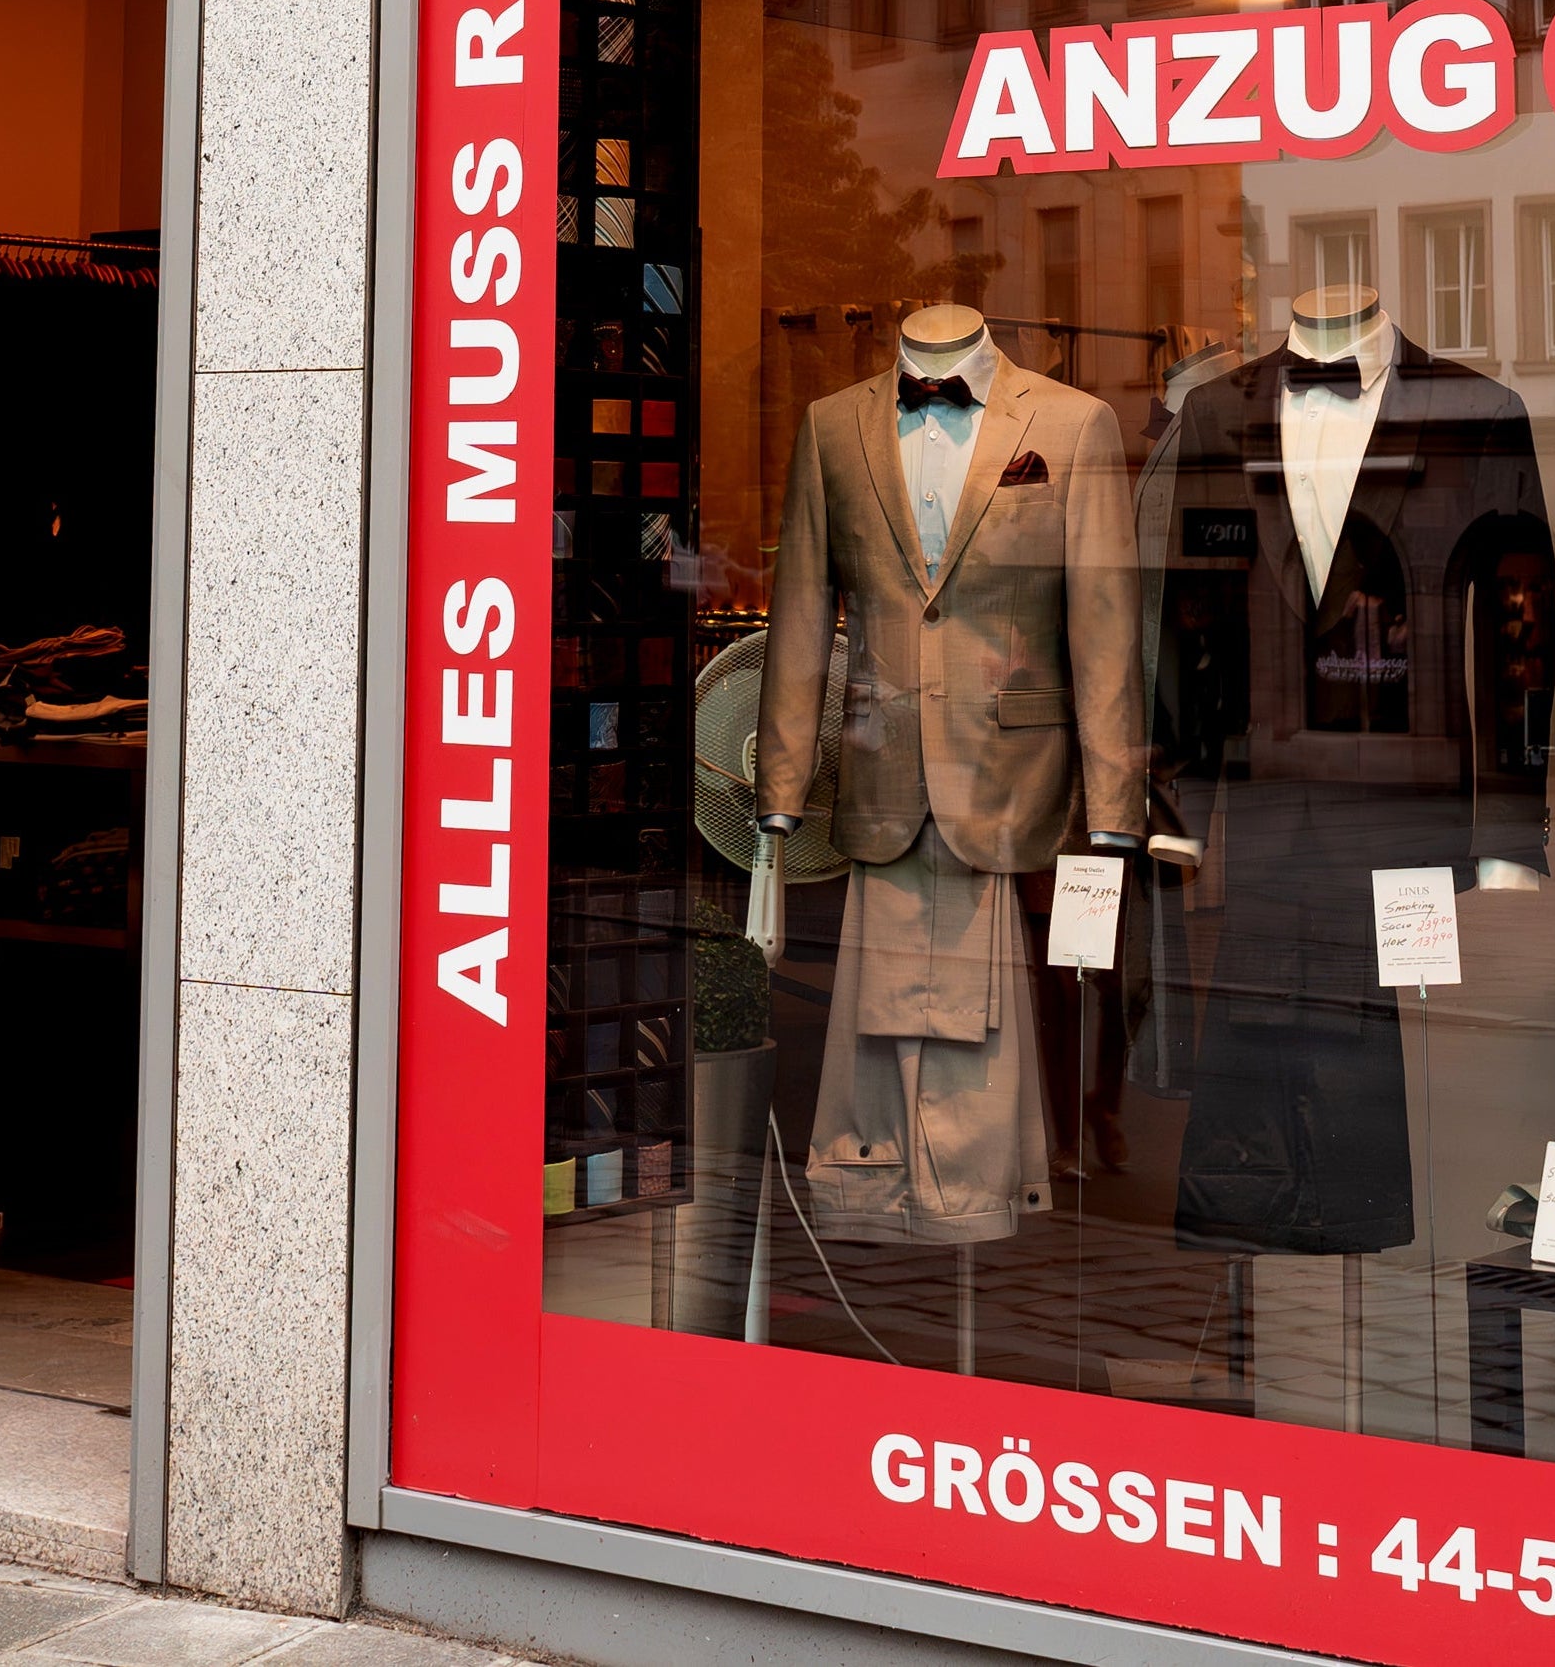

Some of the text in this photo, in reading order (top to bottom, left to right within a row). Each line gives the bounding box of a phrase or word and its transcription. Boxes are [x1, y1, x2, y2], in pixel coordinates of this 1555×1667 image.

[957, 13, 1499, 159] ANZUG
[447, 137, 523, 523] MUSS
[438, 577, 516, 1027] ALLES
[1398, 886, 1430, 897] LINUS
[870, 1433, 1282, 1568] GRÖSSEN
